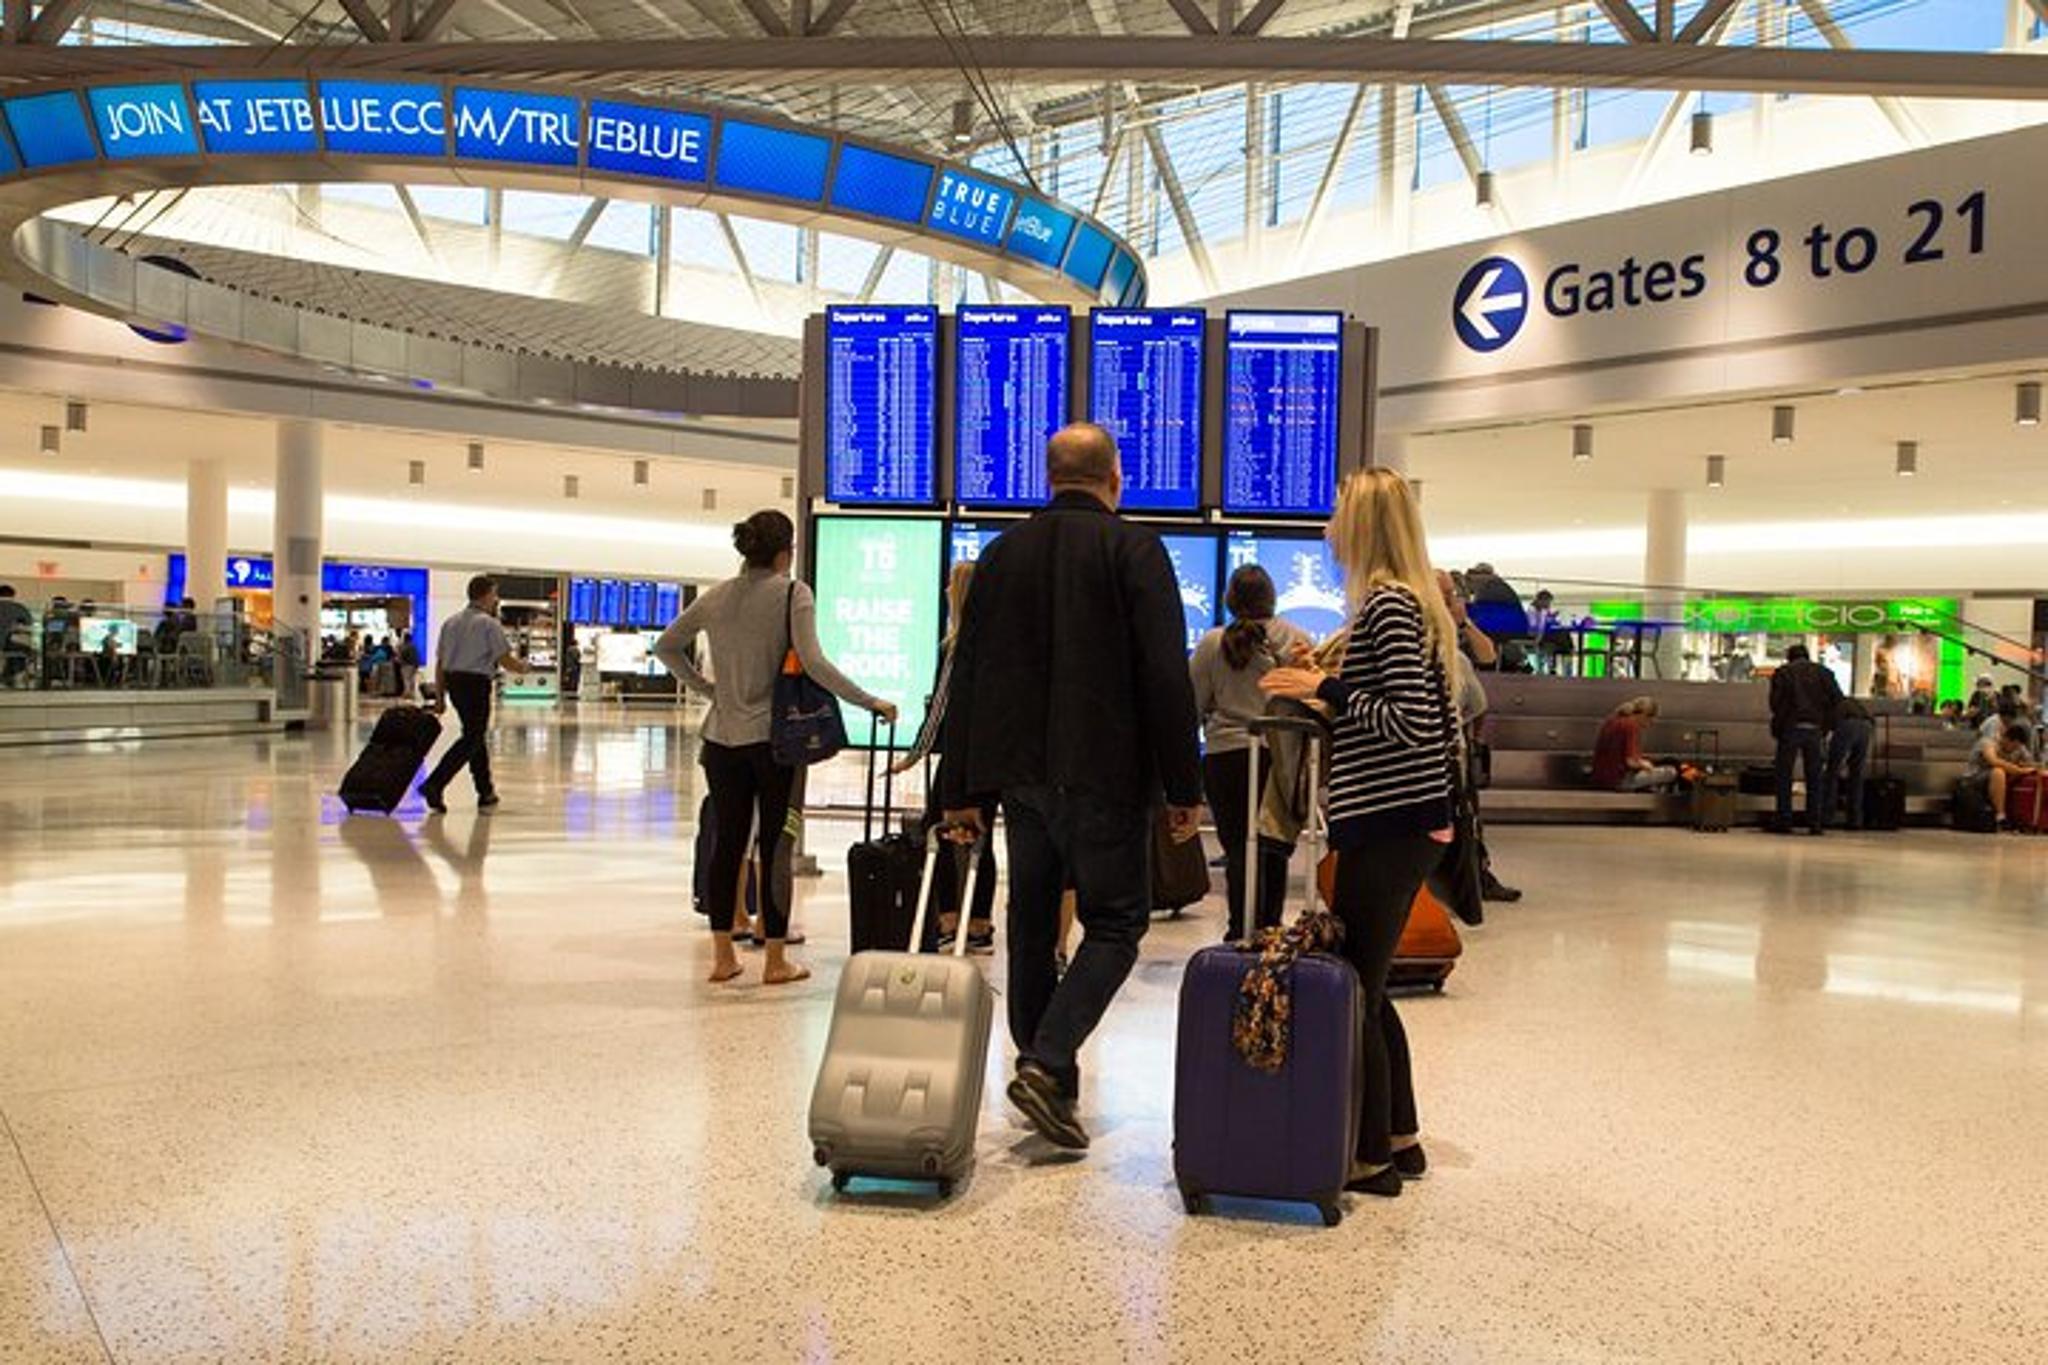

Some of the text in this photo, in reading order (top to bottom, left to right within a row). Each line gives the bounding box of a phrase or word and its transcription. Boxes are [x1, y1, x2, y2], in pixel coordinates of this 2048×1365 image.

[107, 100, 184, 140] JOIN
[199, 98, 232, 132] AT
[941, 175, 1000, 214] TRUE
[932, 200, 994, 235] BLUE
[1543, 191, 1987, 317] Gates 8 to 21
[836, 597, 912, 623] RAISE
[848, 625, 899, 649] THE
